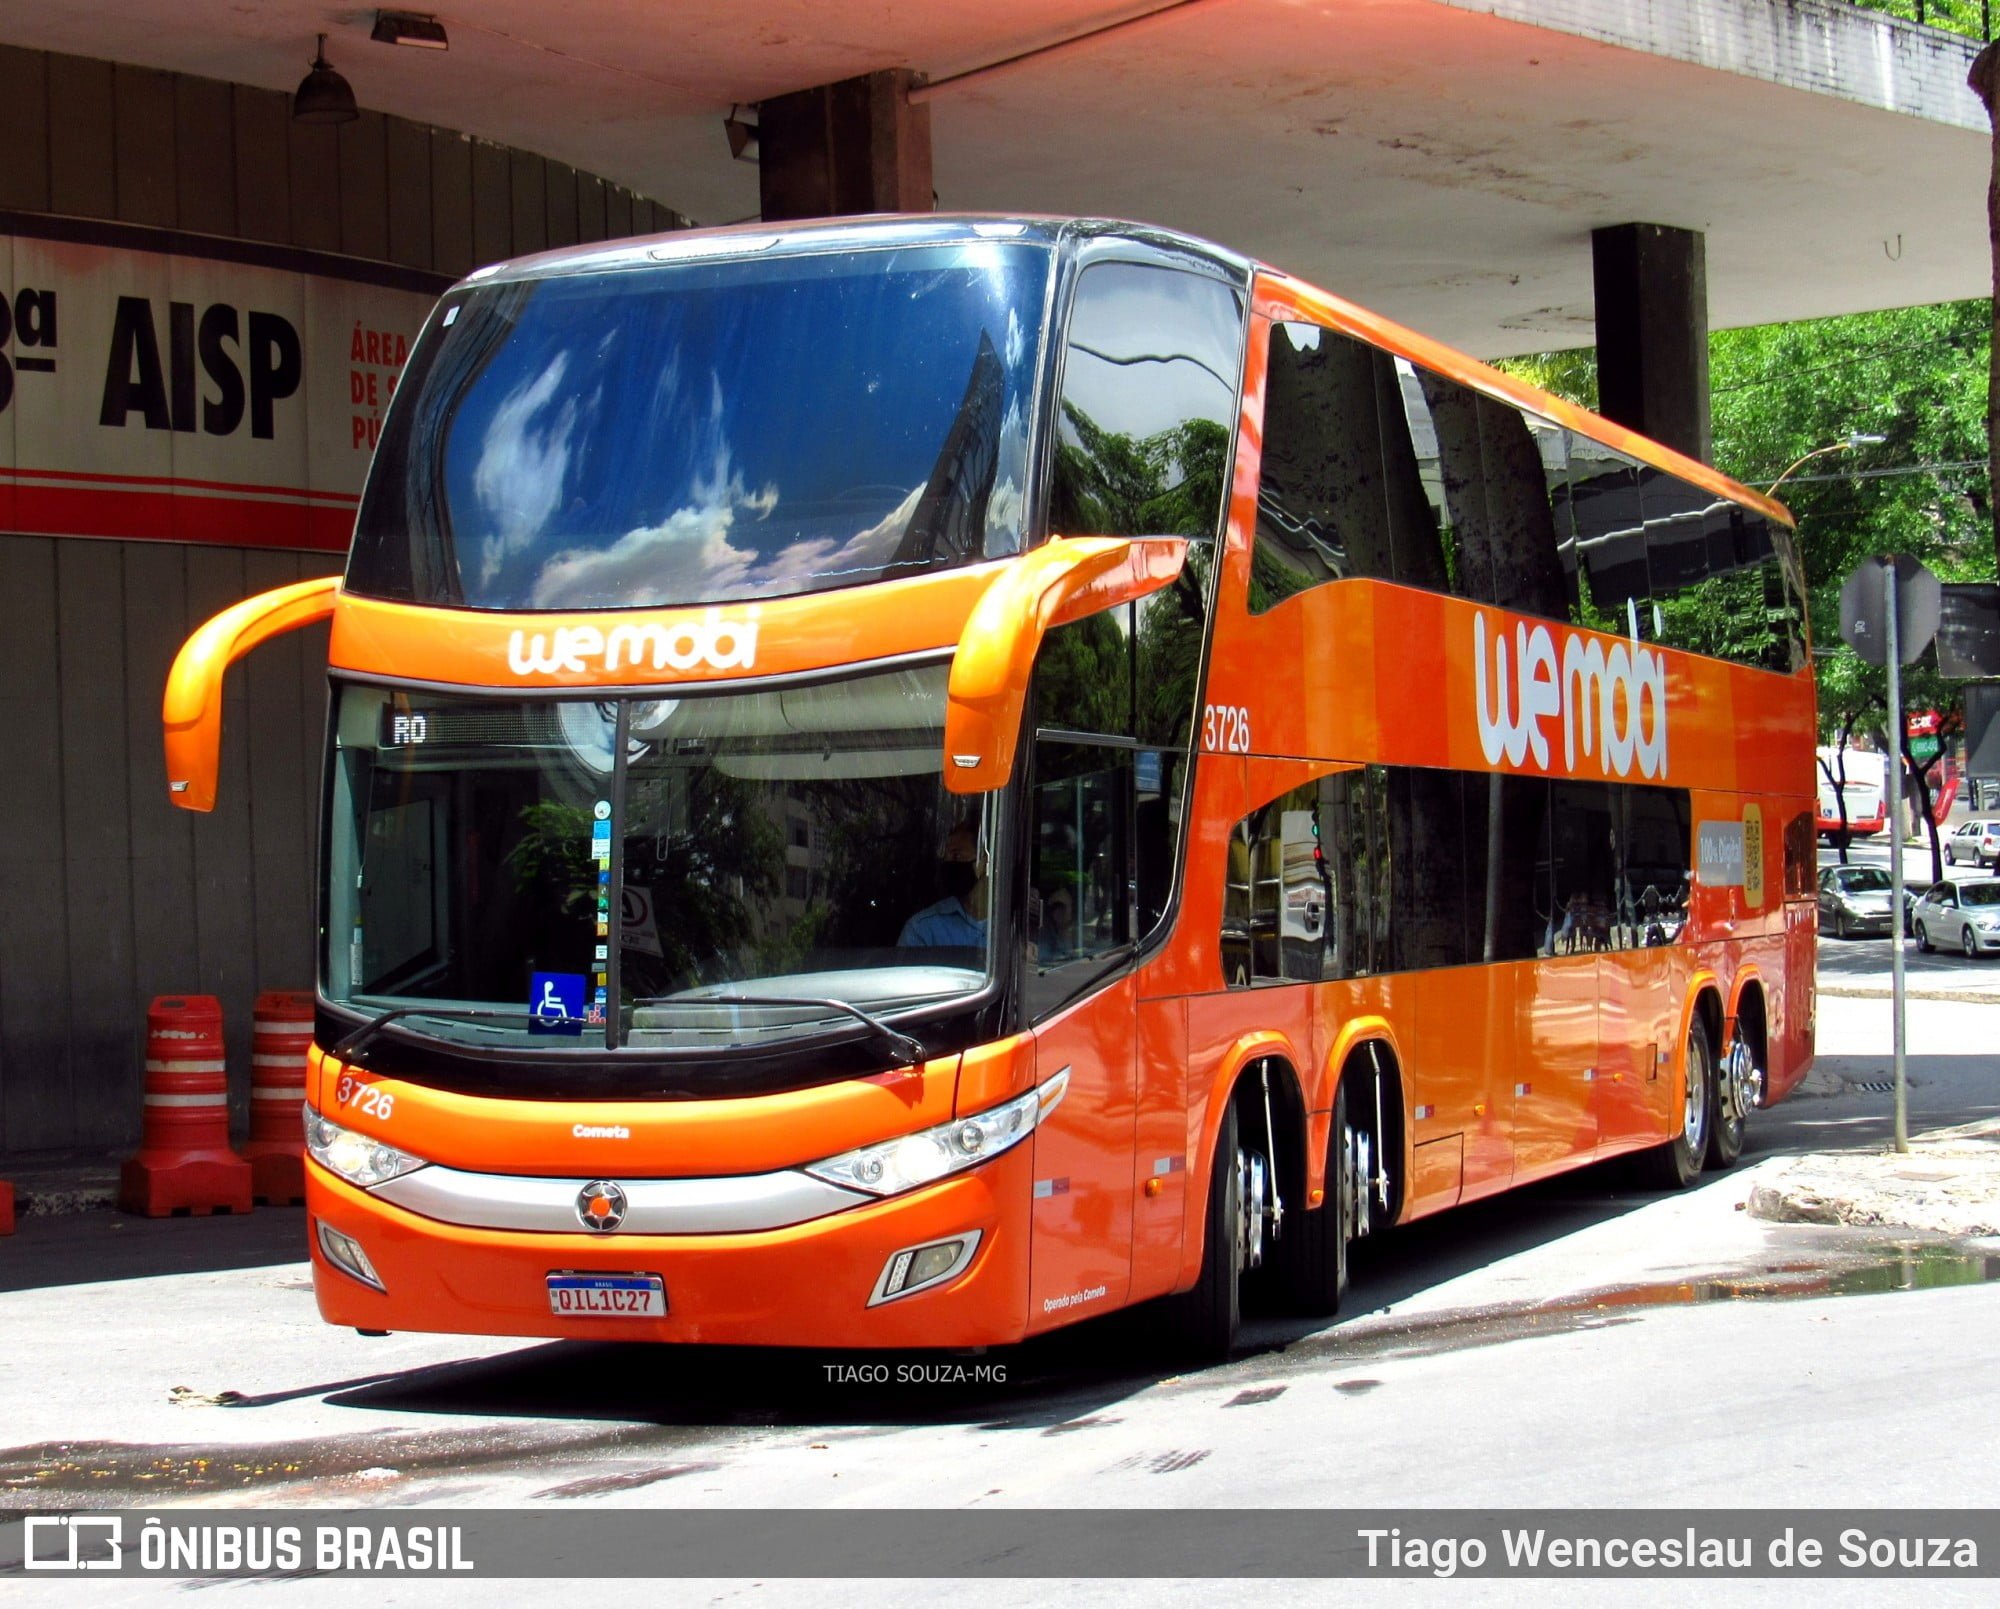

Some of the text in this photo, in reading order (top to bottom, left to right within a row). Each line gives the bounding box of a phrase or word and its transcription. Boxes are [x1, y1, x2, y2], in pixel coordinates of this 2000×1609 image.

[99, 295, 301, 440] AISP
[350, 370, 378, 406] DE
[508, 605, 762, 676] wemobi
[1473, 597, 1667, 780] wemobi
[1205, 703, 1250, 753] 3726
[337, 1076, 395, 1120] 3726
[572, 1123, 630, 1139] Cometa
[559, 1289, 651, 1312] QIL1C27
[1043, 1284, 1106, 1314] Operado pela Cometa
